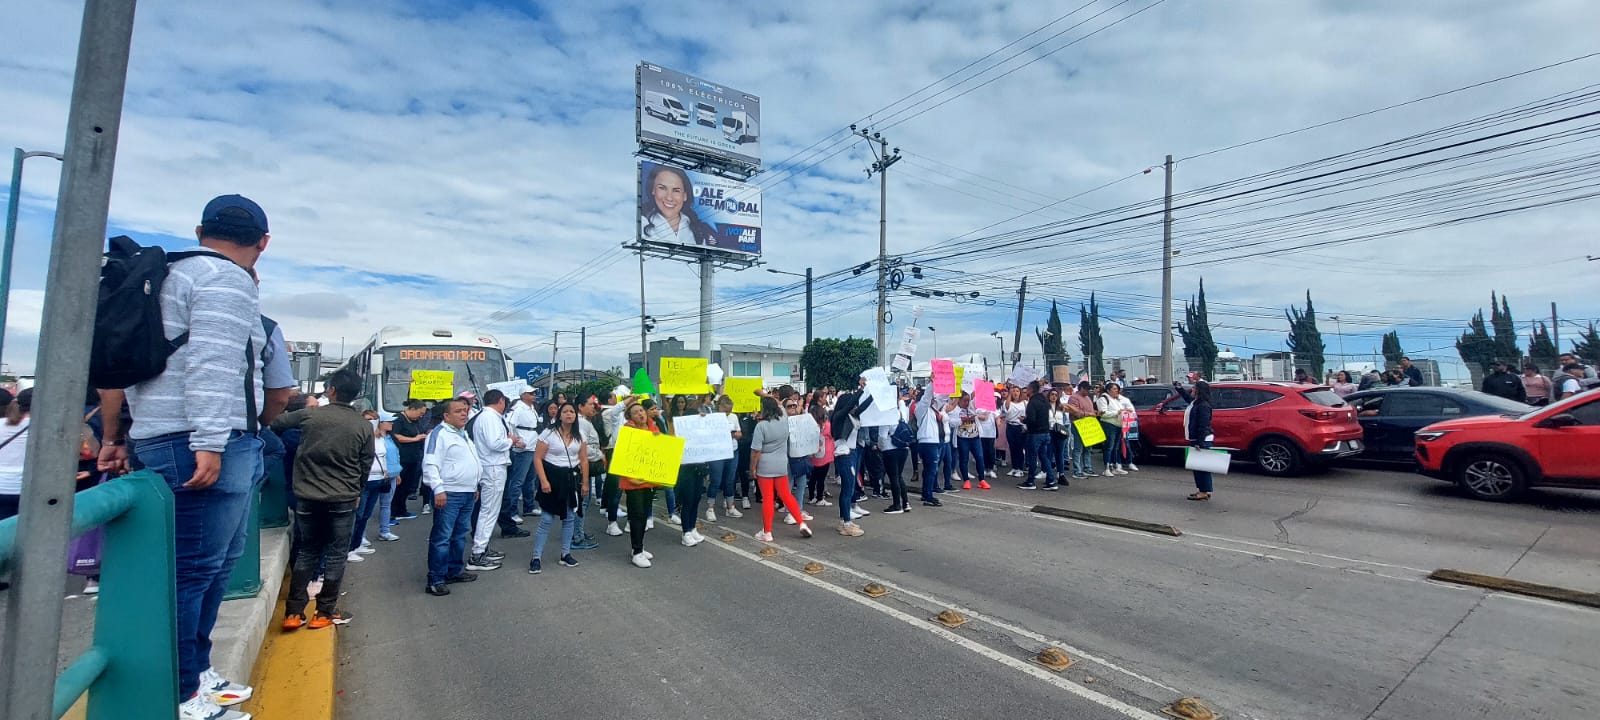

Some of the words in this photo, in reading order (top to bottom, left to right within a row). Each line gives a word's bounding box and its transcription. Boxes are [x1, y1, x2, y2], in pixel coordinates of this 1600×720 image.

[660, 79, 684, 92] 100%
[674, 130, 685, 138] THE
[701, 186, 724, 199] ALE
[699, 198, 715, 207] DEL
[400, 349, 455, 361] ORDINARIO
